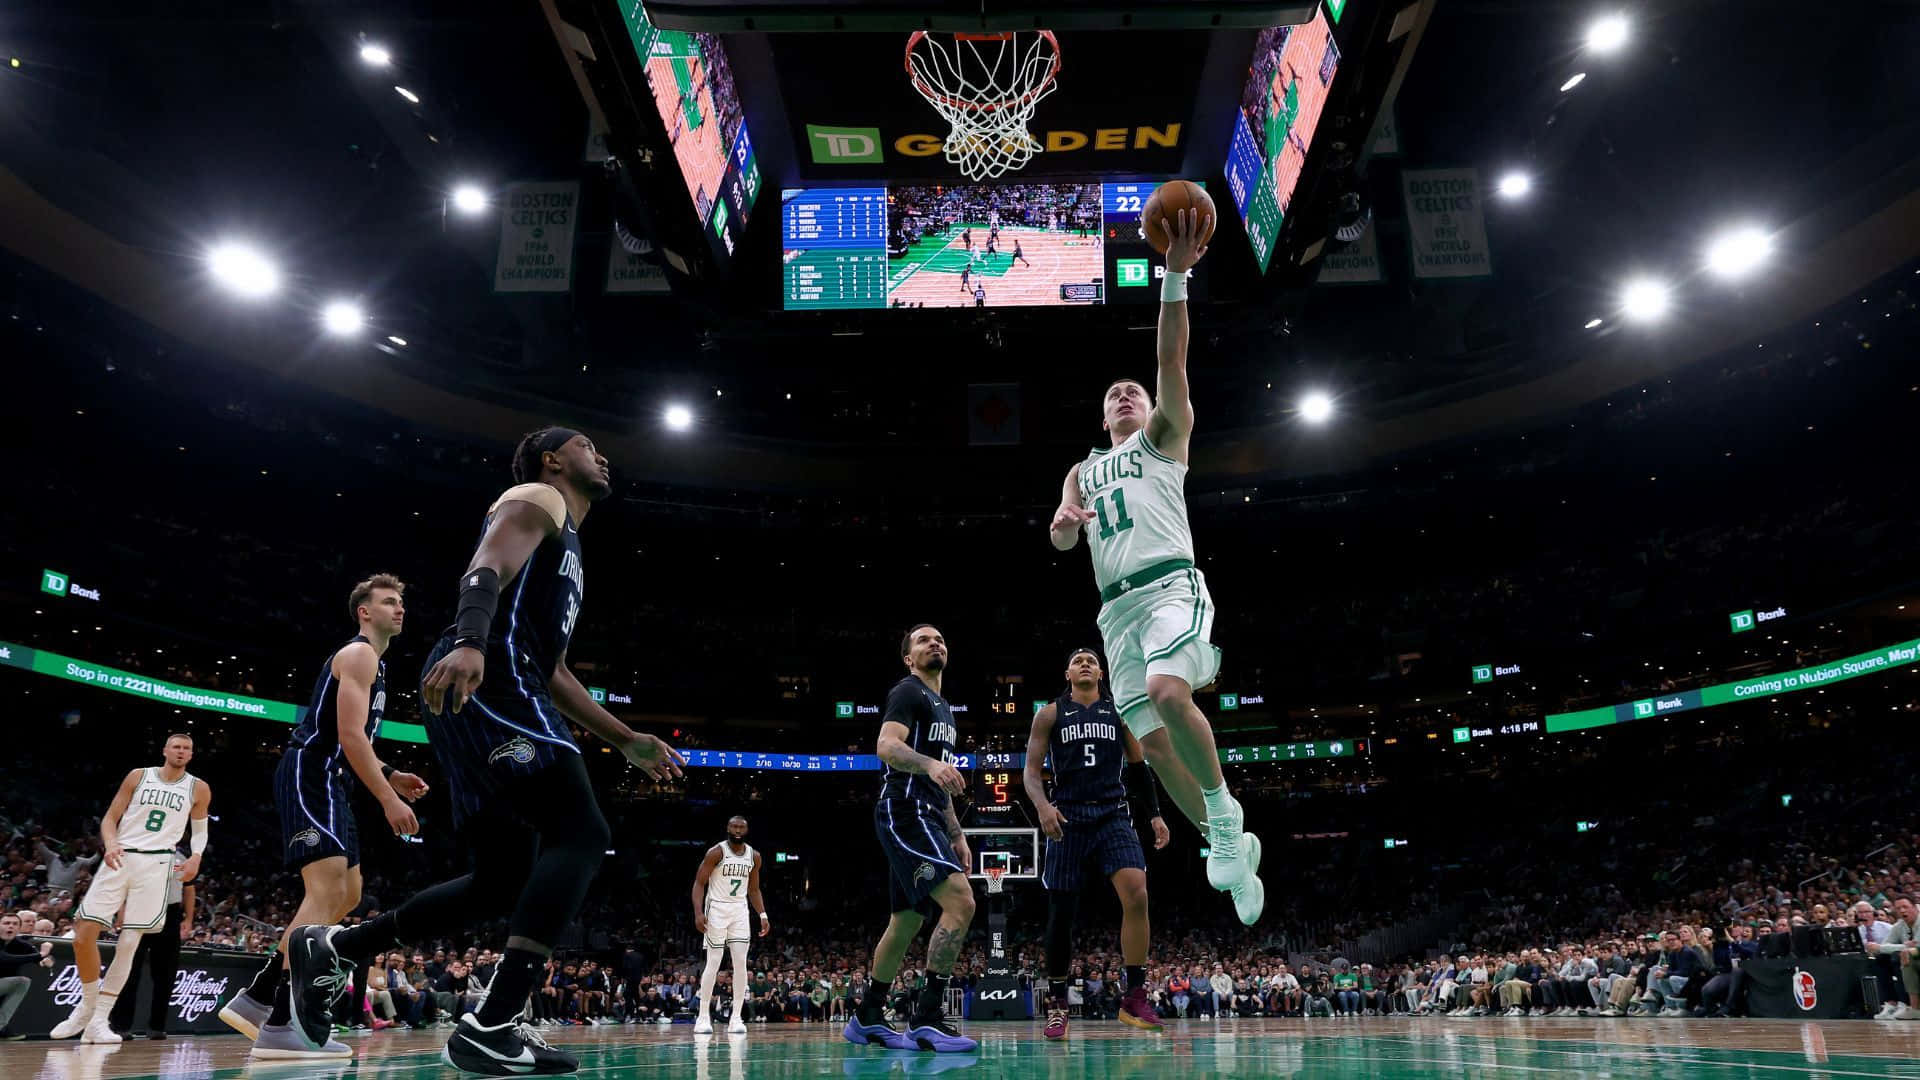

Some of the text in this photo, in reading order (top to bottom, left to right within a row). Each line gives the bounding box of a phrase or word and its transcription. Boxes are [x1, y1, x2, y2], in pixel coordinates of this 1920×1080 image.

[815, 132, 876, 157] TD
[1411, 179, 1473, 195] BOSTON
[510, 192, 574, 209] BOSTON
[1116, 196, 1141, 212] 22
[1416, 197, 1474, 213] CELTICS
[511, 210, 568, 226] CELTICS
[1432, 240, 1471, 252] WORLD
[515, 254, 555, 266] WORLD
[1324, 255, 1375, 270] AMPIONS
[1418, 253, 1486, 266] CHAMPIONS
[502, 267, 566, 281] CHAMPIONS
[1118, 263, 1193, 281] TD Bk
[1094, 487, 1134, 541] 11
[46, 573, 101, 600] TD Bank
[1731, 606, 1786, 628] TD Bank
[1473, 664, 1521, 679] TD Bank
[1734, 679, 1782, 696] Coming
[1784, 676, 1797, 688] to
[1799, 665, 1842, 685] Nubian
[1842, 655, 1888, 674] Square,
[1888, 646, 1917, 664] May
[66, 663, 267, 714] Stop in at 2221 Washington Street.
[608, 693, 632, 704] Bank
[1219, 695, 1265, 707] TD Bank
[1633, 697, 1683, 715] TD Bank
[837, 704, 880, 715] TD Bank
[991, 702, 1015, 713] 4:18
[1061, 722, 1116, 744] ORLANDO
[1456, 730, 1469, 740] TD
[1471, 728, 1493, 737] Bank
[1522, 722, 1538, 732] PM
[951, 756, 969, 768] 22
[986, 753, 1010, 763] 9:13
[1084, 744, 1096, 767] 5
[984, 773, 1009, 785] 9:13
[140, 788, 185, 812] CELTICS
[994, 784, 1007, 803] 5
[145, 809, 167, 833] 8
[729, 879, 742, 897] 7
[987, 967, 1009, 976] Google
[170, 992, 219, 1022] Here
